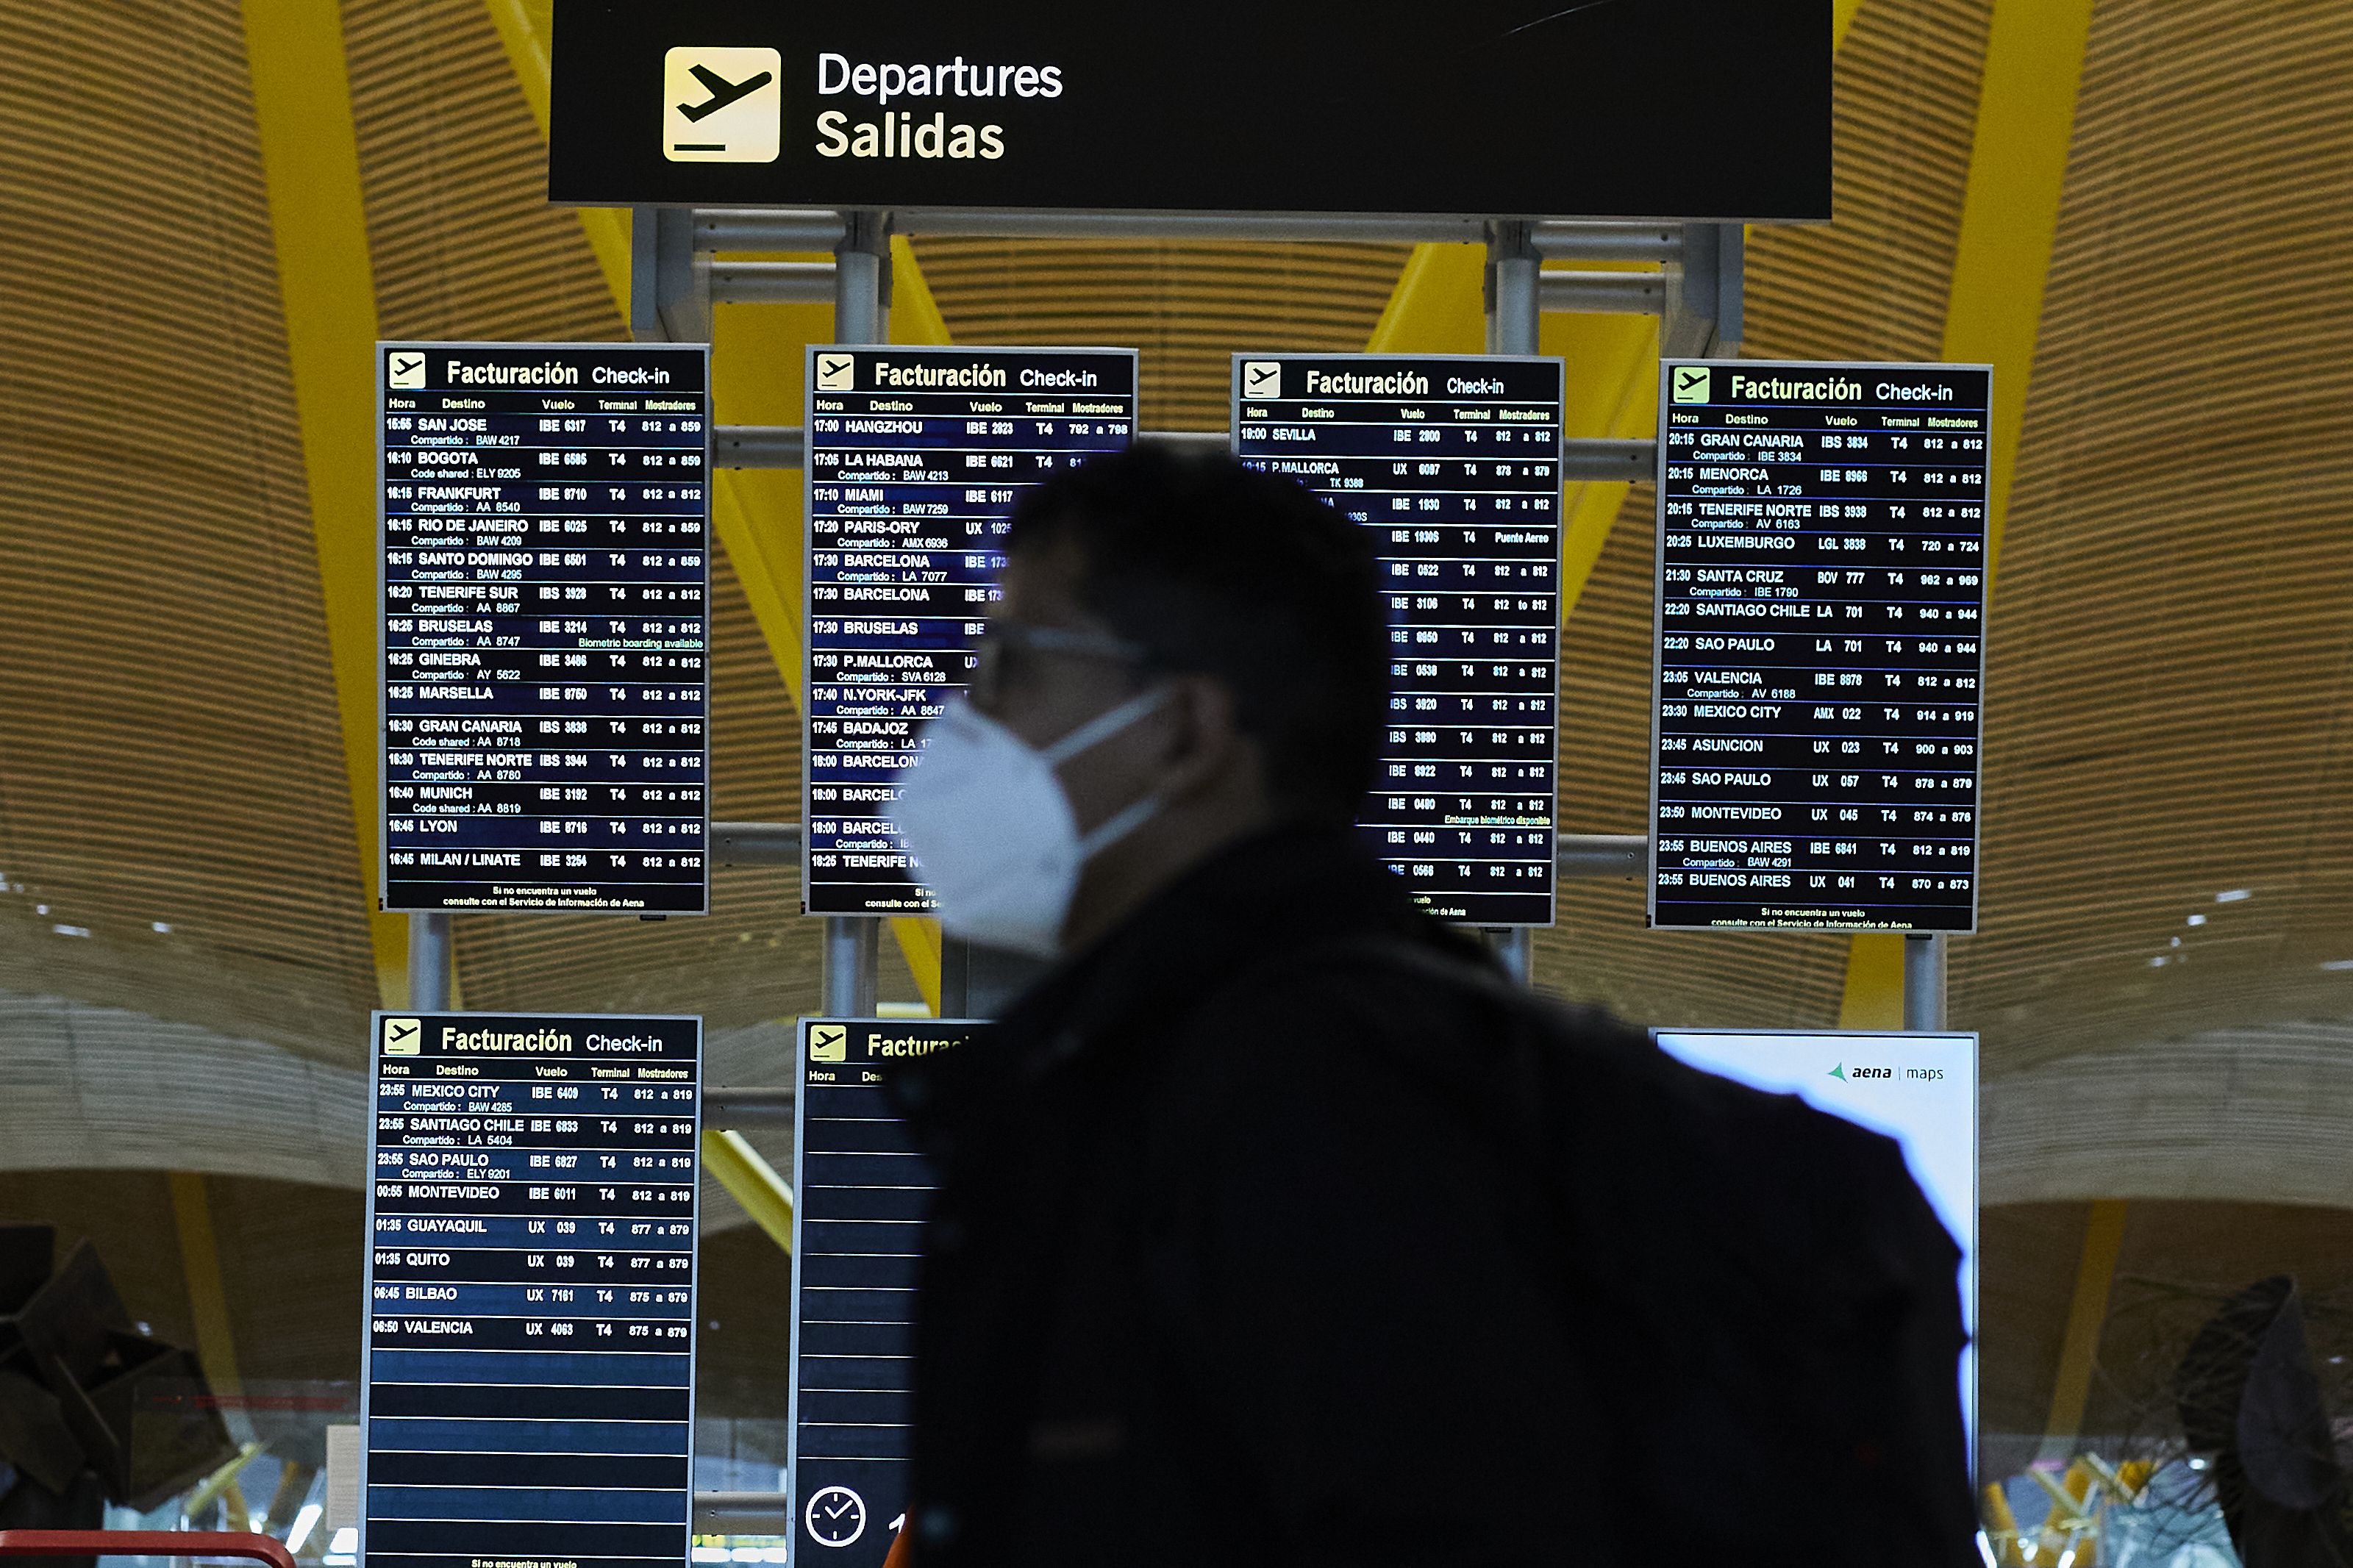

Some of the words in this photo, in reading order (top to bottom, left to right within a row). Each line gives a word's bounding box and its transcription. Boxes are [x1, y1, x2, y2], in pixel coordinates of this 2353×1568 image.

[818, 53, 1063, 105] Departures
[815, 110, 1004, 160] Salidas
[447, 360, 579, 384] Facturación
[592, 366, 670, 384] Check-in
[875, 362, 1006, 387] Facturación
[1019, 368, 1097, 387] Check-in
[1307, 370, 1429, 395] Facturación
[1446, 377, 1504, 395] Check-in
[1732, 375, 1862, 401] Facturación
[1875, 382, 1953, 401] Check-in
[388, 398, 416, 409] Hora
[442, 398, 486, 409] Destino
[541, 399, 575, 410] Vuelo
[598, 399, 638, 410] Terminal
[645, 399, 696, 411] Mostradores
[816, 399, 844, 411] Hora
[869, 400, 913, 412] Destino
[969, 401, 1003, 412] Vuelo
[1025, 401, 1065, 413] Terminal
[1072, 402, 1124, 414] Mostradores
[1246, 407, 1268, 418] Hora
[1302, 407, 1335, 418] Destino
[1400, 408, 1426, 420] Vuelo
[1453, 409, 1491, 420] Terminal
[1499, 409, 1550, 420] Mostradores
[1672, 412, 1699, 423] Hora
[1725, 413, 1769, 425] Destino
[1825, 415, 1858, 426] Vuelo
[1881, 416, 1920, 427] Terminal
[1927, 417, 1979, 429] Mostradores
[418, 418, 447, 432] SAN
[449, 418, 488, 432] JOSE
[539, 419, 560, 432] IBE
[608, 419, 626, 432] T4
[814, 419, 840, 432] 17:00
[845, 420, 923, 434] HANGZHOU
[966, 421, 988, 434] IBE
[1035, 422, 1054, 435] T4
[476, 434, 498, 445] BAW
[498, 434, 521, 445] 4217
[1272, 428, 1316, 441] SEVILLA
[1393, 429, 1412, 442] IBE
[1464, 430, 1478, 443] T4
[1668, 432, 1695, 445] 20:15
[1700, 433, 1740, 447] GRAN
[1743, 434, 1804, 448] CANARIA
[1890, 437, 1908, 450] T4
[418, 451, 479, 465] BOGOTA
[845, 454, 864, 466] LA
[865, 454, 924, 467] HABANA
[1035, 455, 1053, 468] T4
[1271, 461, 1340, 475] P.MALLORCA
[1393, 462, 1407, 476] UX
[1463, 463, 1477, 476] T4
[1699, 467, 1769, 481] MENORCA
[1820, 469, 1840, 482] IBE
[418, 486, 501, 500] FRANKFURT
[609, 488, 626, 501] T4
[813, 488, 839, 501] 17:10
[845, 488, 884, 502] MIAMI
[1757, 484, 1772, 495] LA
[418, 518, 443, 532] RIO
[446, 519, 466, 531] DE
[468, 519, 529, 532] JANEIRO
[844, 520, 921, 534] PARIS-ORY
[965, 521, 983, 535] UX
[1495, 531, 1524, 543] Puente
[1524, 531, 1549, 543] Aereo
[1698, 535, 1796, 550] LUXEMBURGO
[1818, 537, 1839, 551] LGL
[418, 551, 465, 566] SANTO
[468, 552, 534, 566] DOMINGO
[844, 554, 931, 568] BARCELONA
[1665, 568, 1691, 581] 21:30
[1696, 569, 1743, 582] SANTA
[1746, 570, 1784, 583] CRUZ
[1846, 571, 1865, 584] 777
[418, 585, 487, 599] TENERIFE
[489, 586, 518, 599] SUR
[843, 587, 930, 601] BARCELONA
[1664, 603, 1690, 615] 22:20
[1696, 603, 1767, 617] SANTIAGO
[1769, 604, 1810, 617] CHILE
[1816, 605, 1833, 617] LA
[1846, 606, 1863, 618] 701
[418, 619, 493, 633] BRUSELAS
[609, 620, 626, 634] T4
[843, 621, 918, 635] BRUSELAS
[578, 637, 621, 648] Biometric
[623, 638, 662, 649] boarding
[664, 638, 704, 648] available
[1695, 637, 1725, 651] SAO
[1727, 637, 1775, 651] PAULO
[1918, 642, 1938, 654] 940
[1956, 642, 1977, 654] 944
[418, 653, 482, 666] GINEBRA
[843, 654, 934, 668] P.MALLORCA
[1663, 670, 1688, 683] 23:05
[1693, 671, 1763, 684] VALENCIA
[419, 686, 494, 700] MARSELLA
[812, 687, 838, 701] 17:40
[843, 688, 926, 702] N.YORK-JFK
[1662, 704, 1688, 717] 23:30
[1693, 704, 1747, 718] MEXICO
[1749, 706, 1782, 719] CITY
[1813, 706, 1835, 720] AMX
[1916, 709, 1937, 721] 914
[418, 719, 459, 733] GRAN
[461, 720, 523, 733] CANARIA
[812, 721, 838, 734] 17:45
[843, 721, 909, 735] BADAJOZ
[1661, 738, 1687, 751] 23:45
[1692, 738, 1763, 752] ASUNCION
[419, 753, 484, 766] TENERIFE
[486, 753, 533, 767] NORTE
[420, 786, 473, 800] MUNICH
[1691, 806, 1782, 820] MONTEVIDEO
[419, 820, 457, 833] LYON
[1690, 840, 1748, 853] BUENOS
[1750, 841, 1792, 854] AIRES
[420, 853, 462, 866] MILAN
[472, 853, 521, 867] LINATE
[843, 855, 906, 867] TENERIFE
[1747, 856, 1771, 867] BAW
[1771, 857, 1791, 867] 4291
[442, 1027, 572, 1052] Facturación
[585, 1034, 663, 1052] Check-in
[382, 1064, 410, 1075] Hora
[436, 1064, 479, 1076] Destino
[535, 1066, 568, 1077] Vuelo
[590, 1067, 630, 1078] Terminal
[809, 1070, 835, 1081] Hora
[1852, 1067, 1892, 1078] aena
[1907, 1069, 1943, 1082] maps
[411, 1084, 465, 1098] MEXICO
[468, 1085, 500, 1098] CITY
[532, 1086, 553, 1099] IBE
[601, 1087, 618, 1100] T4
[410, 1117, 481, 1131] SANTIAGO
[483, 1118, 524, 1132] CHILE
[408, 1185, 500, 1200] MONTEVIDEO
[529, 1187, 550, 1200] IBE
[407, 1218, 488, 1234] GUAYAQUIL
[528, 1220, 546, 1234] UX
[406, 1253, 451, 1267] QUITO
[405, 1286, 458, 1300] BILBAO
[404, 1320, 474, 1334] VALENCIA
[550, 1322, 574, 1336] 4063
